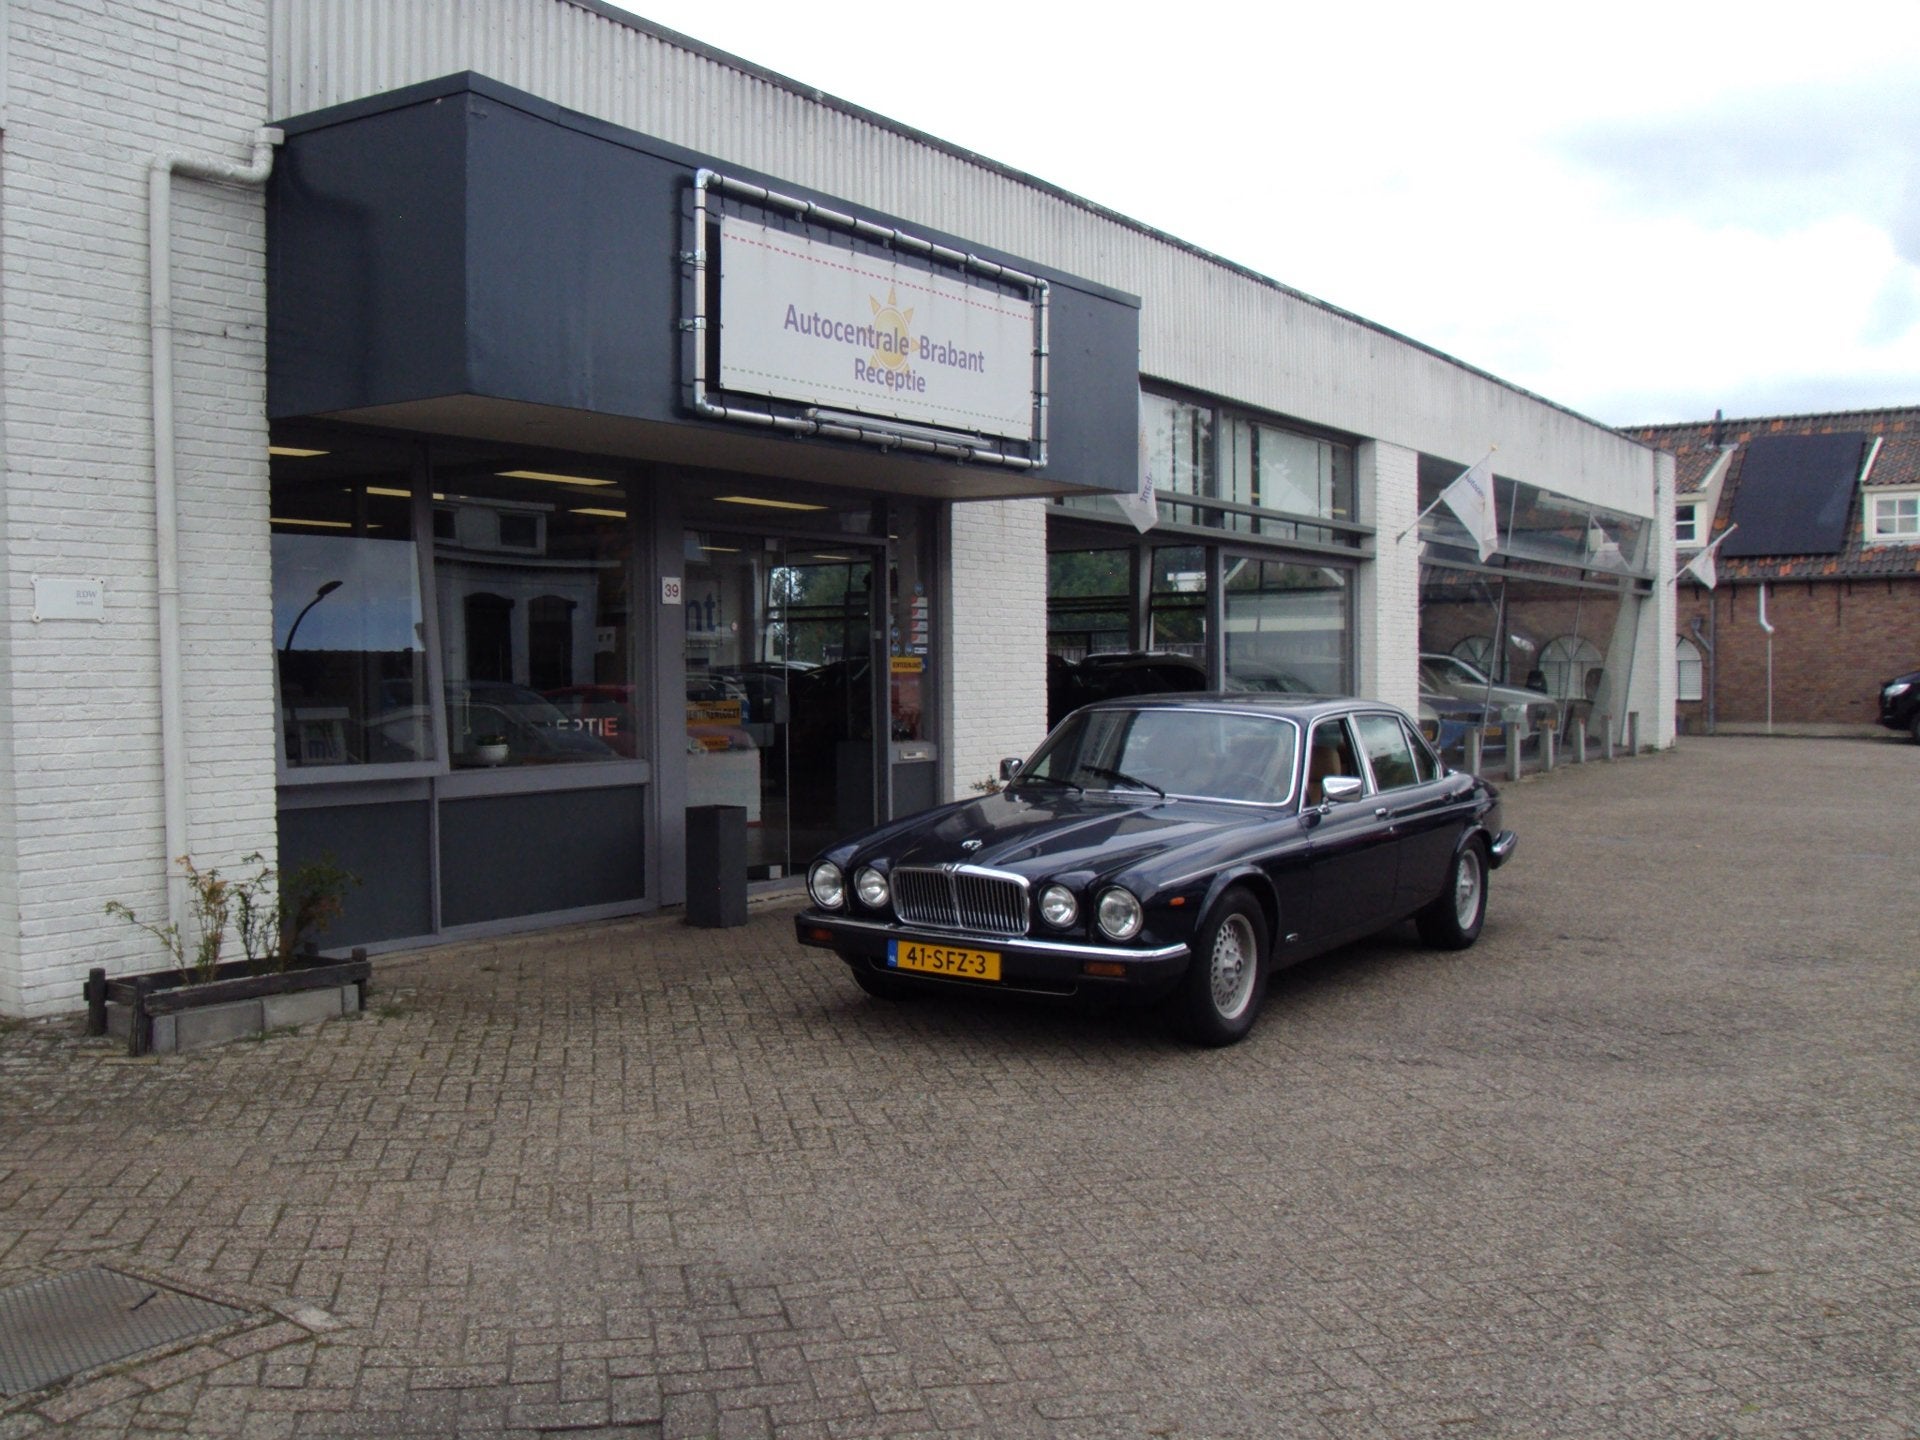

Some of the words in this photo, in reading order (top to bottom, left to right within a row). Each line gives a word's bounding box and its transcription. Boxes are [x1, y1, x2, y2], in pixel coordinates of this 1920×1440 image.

[784, 304, 909, 357] Autocentrale
[919, 335, 985, 373] Brabant
[854, 357, 926, 393] Receptie
[665, 584, 679, 598] 39
[906, 946, 986, 975] 41-SFZ-3
